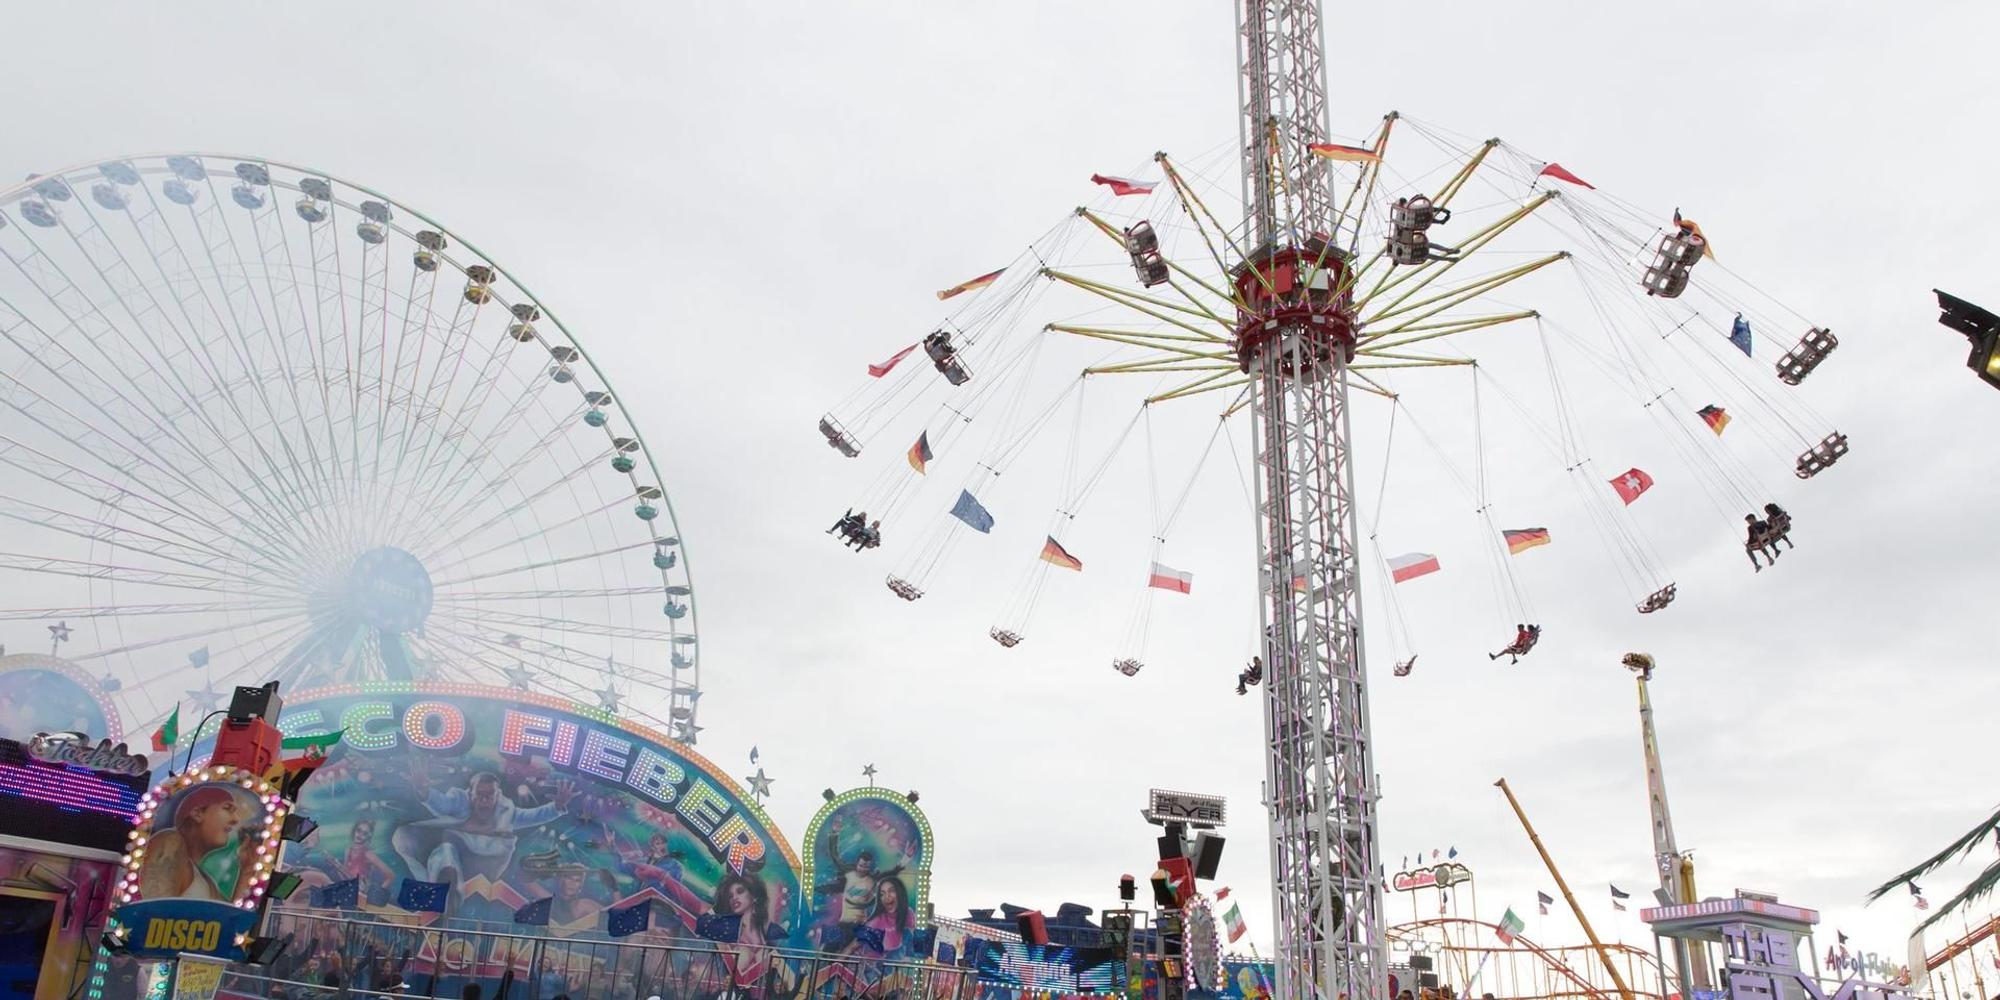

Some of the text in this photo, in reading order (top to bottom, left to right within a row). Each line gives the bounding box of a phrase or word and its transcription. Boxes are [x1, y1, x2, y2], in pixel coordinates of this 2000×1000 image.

[498, 707, 767, 877] FIEBER
[1157, 795, 1179, 805] THE
[1156, 803, 1221, 821] FLYER
[144, 918, 221, 951] DISCO
[1722, 925, 1794, 966] THE
